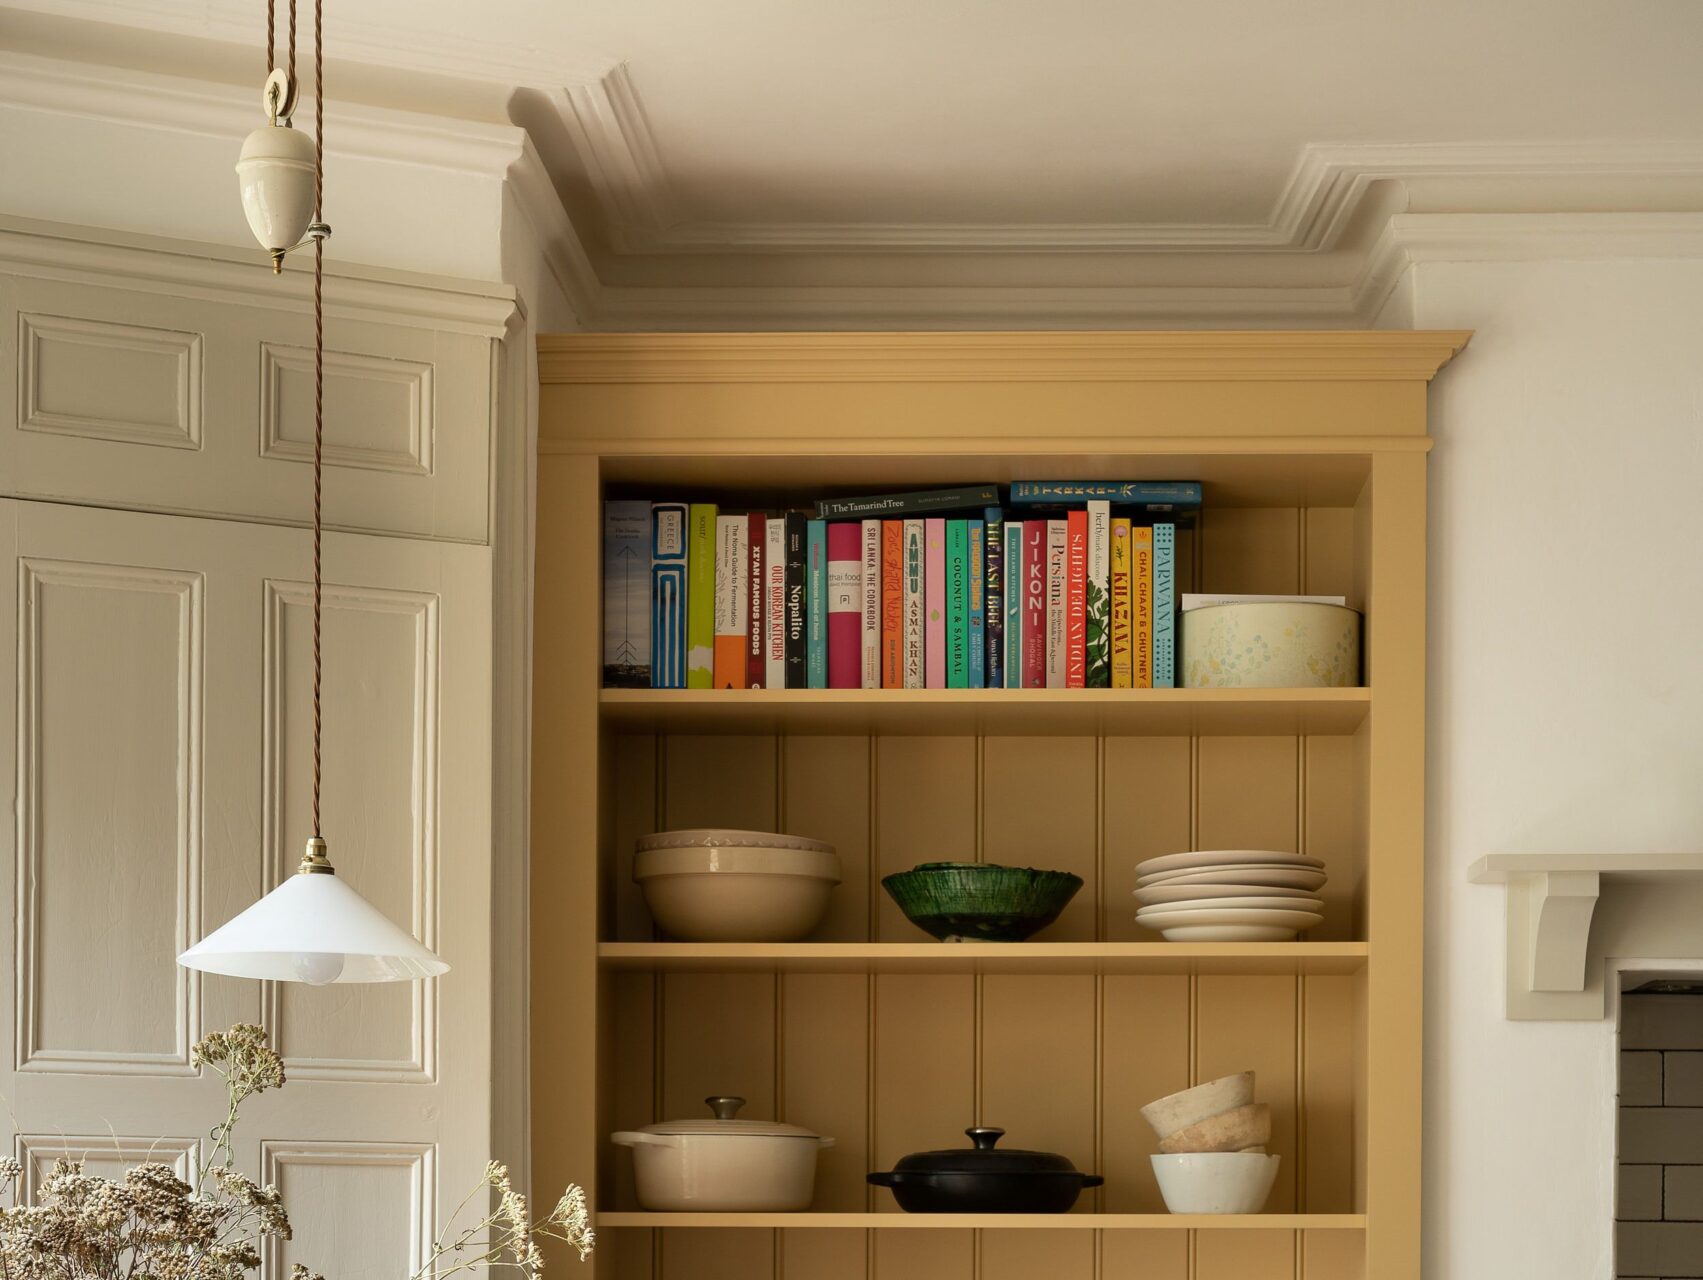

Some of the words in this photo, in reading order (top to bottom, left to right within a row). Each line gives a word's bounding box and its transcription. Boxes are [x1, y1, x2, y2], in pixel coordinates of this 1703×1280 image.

[1042, 486, 1116, 495] TARKARI
[667, 515, 675, 551] GREECE
[866, 527, 876, 541] SRI
[987, 522, 1000, 551] THE
[866, 543, 876, 570] LANKA:
[909, 533, 919, 594] AMMU
[987, 555, 1000, 591] LAST
[1138, 551, 1147, 580] CHAI,
[731, 577, 738, 585] to
[771, 566, 783, 584] OUR
[829, 573, 843, 581] thai
[844, 572, 861, 582] food
[866, 573, 876, 587] THE
[954, 557, 962, 612] COCONUT
[1029, 531, 1043, 627] JIKONI
[1051, 545, 1066, 606] Persiana
[1070, 534, 1083, 619] DELIGHTS
[1157, 547, 1171, 634] PARWANA
[730, 586, 738, 627] Fermentation
[752, 578, 761, 619] FAMOUS
[771, 587, 783, 621] KOREAN
[788, 585, 803, 640] Nopalito
[866, 589, 876, 631] COOKBOOK
[1113, 572, 1128, 655] KHAZANA
[1139, 582, 1147, 618] CHAAT
[909, 600, 918, 636] ASMA
[954, 616, 962, 624] &
[1139, 620, 1147, 628] &
[752, 621, 761, 656] FOODS
[771, 624, 783, 661] KITCHEN
[954, 628, 962, 675] SAMBAL
[1070, 621, 1083, 680] INDIAN
[1139, 631, 1147, 681] CHUTNEY
[909, 641, 918, 676] KHAN
